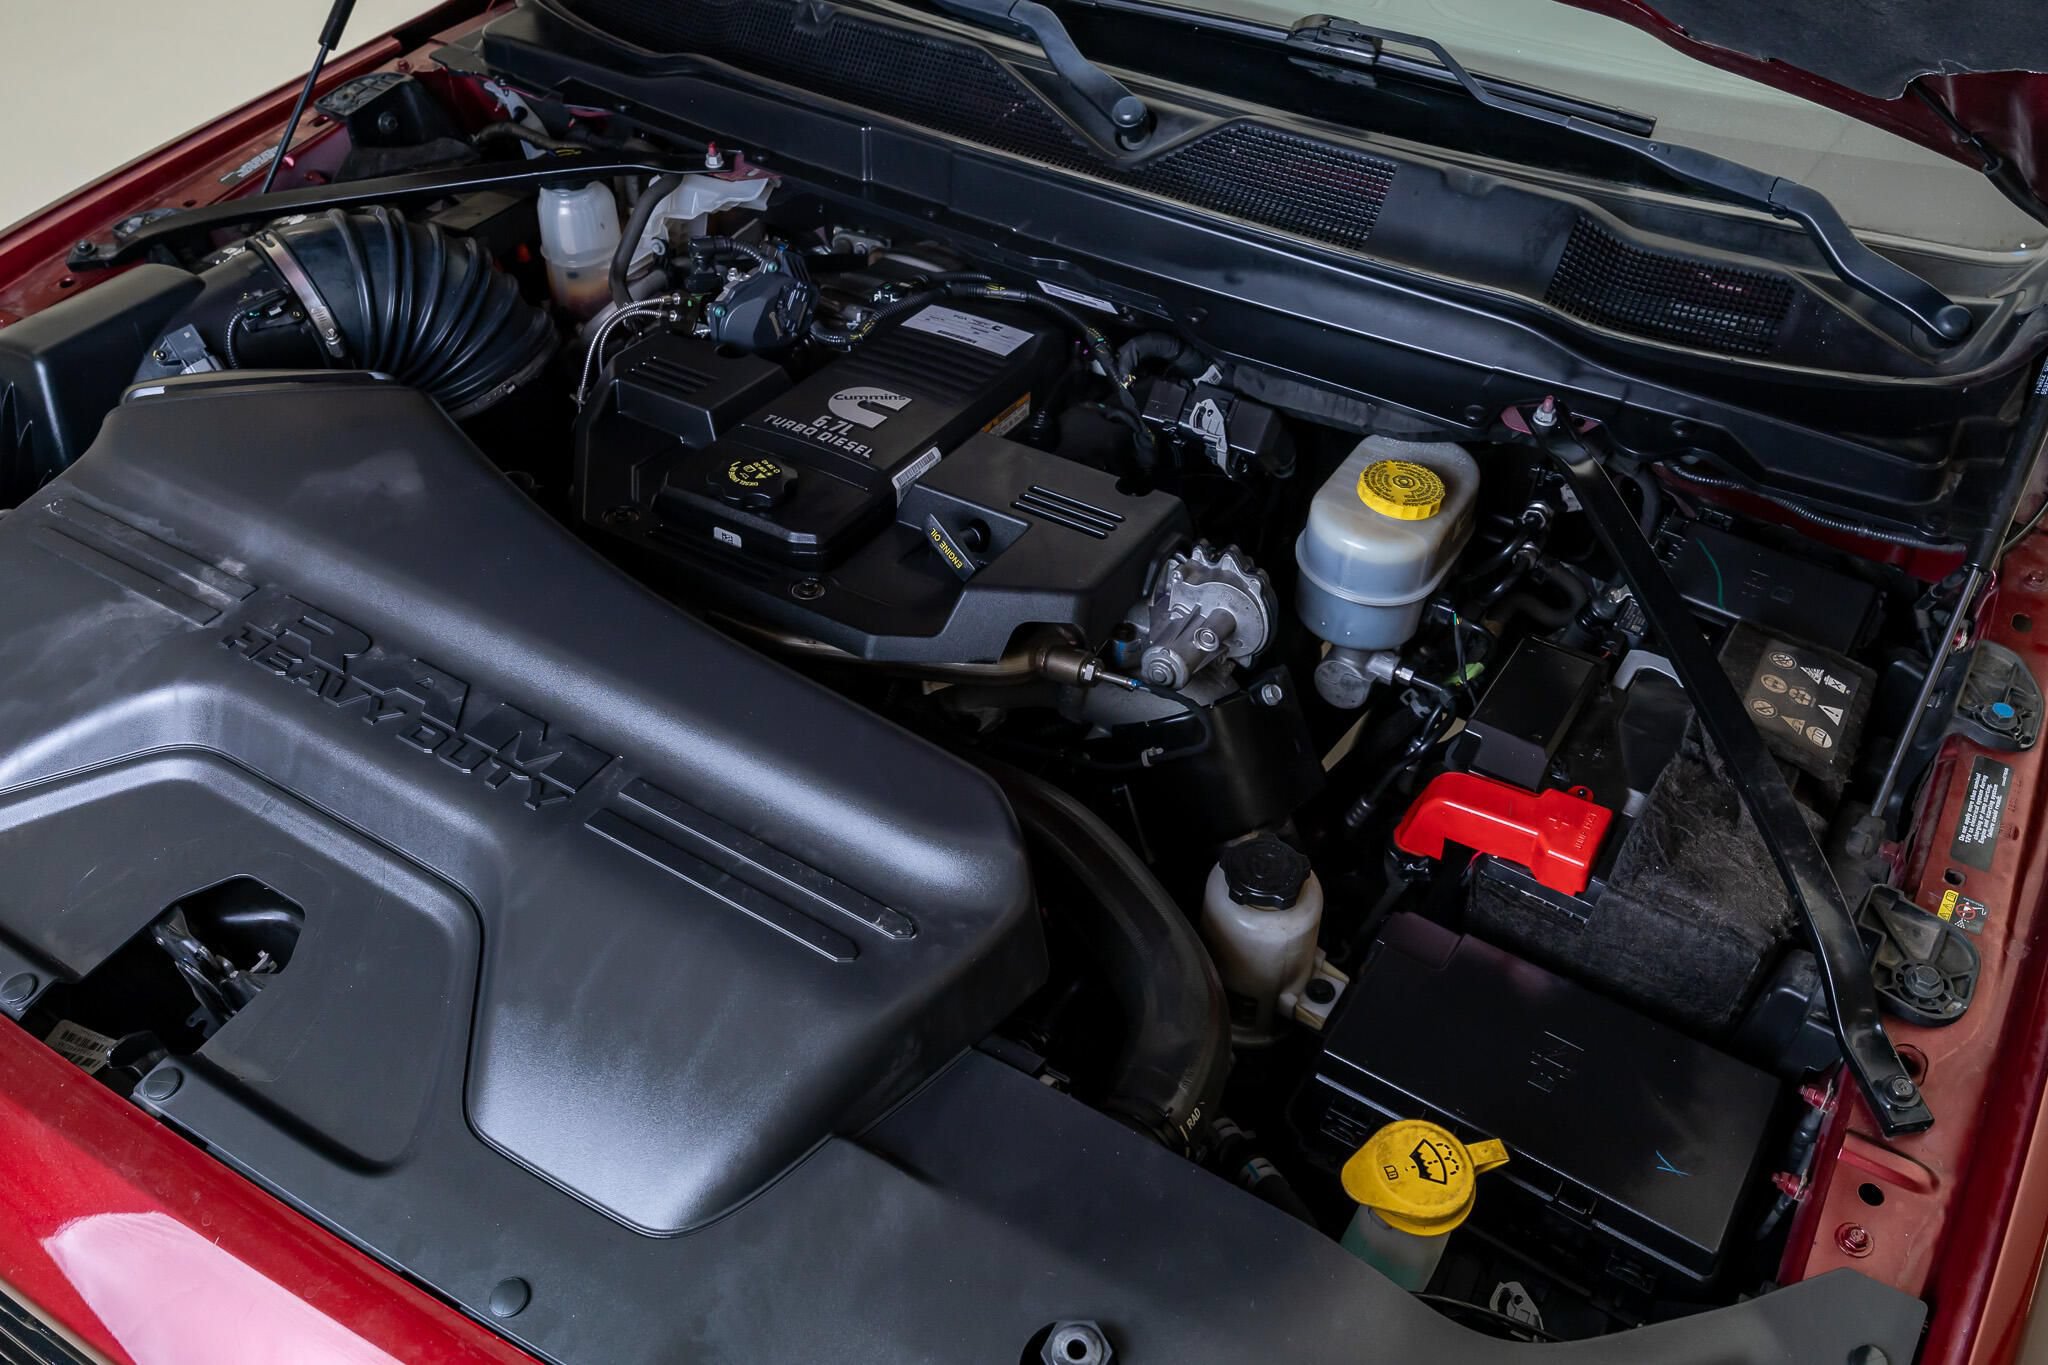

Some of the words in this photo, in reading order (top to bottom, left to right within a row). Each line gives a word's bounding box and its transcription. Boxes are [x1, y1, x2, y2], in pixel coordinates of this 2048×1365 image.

[763, 414, 818, 436] TURBO
[817, 432, 874, 459] DIESEL
[812, 415, 854, 437] 6.7L
[930, 527, 941, 542] OIL
[939, 540, 963, 569] ENGINE
[244, 594, 622, 794] RAM
[218, 622, 406, 726] HEAVY
[395, 718, 573, 811] DUTY
[1969, 805, 1979, 827] electrical
[1979, 775, 1988, 789] during
[1984, 800, 1995, 819] starting
[1964, 813, 1973, 825] apply
[1973, 820, 1983, 840] charging
[1979, 802, 1987, 814] jump
[1186, 1107, 1201, 1130] RAD
